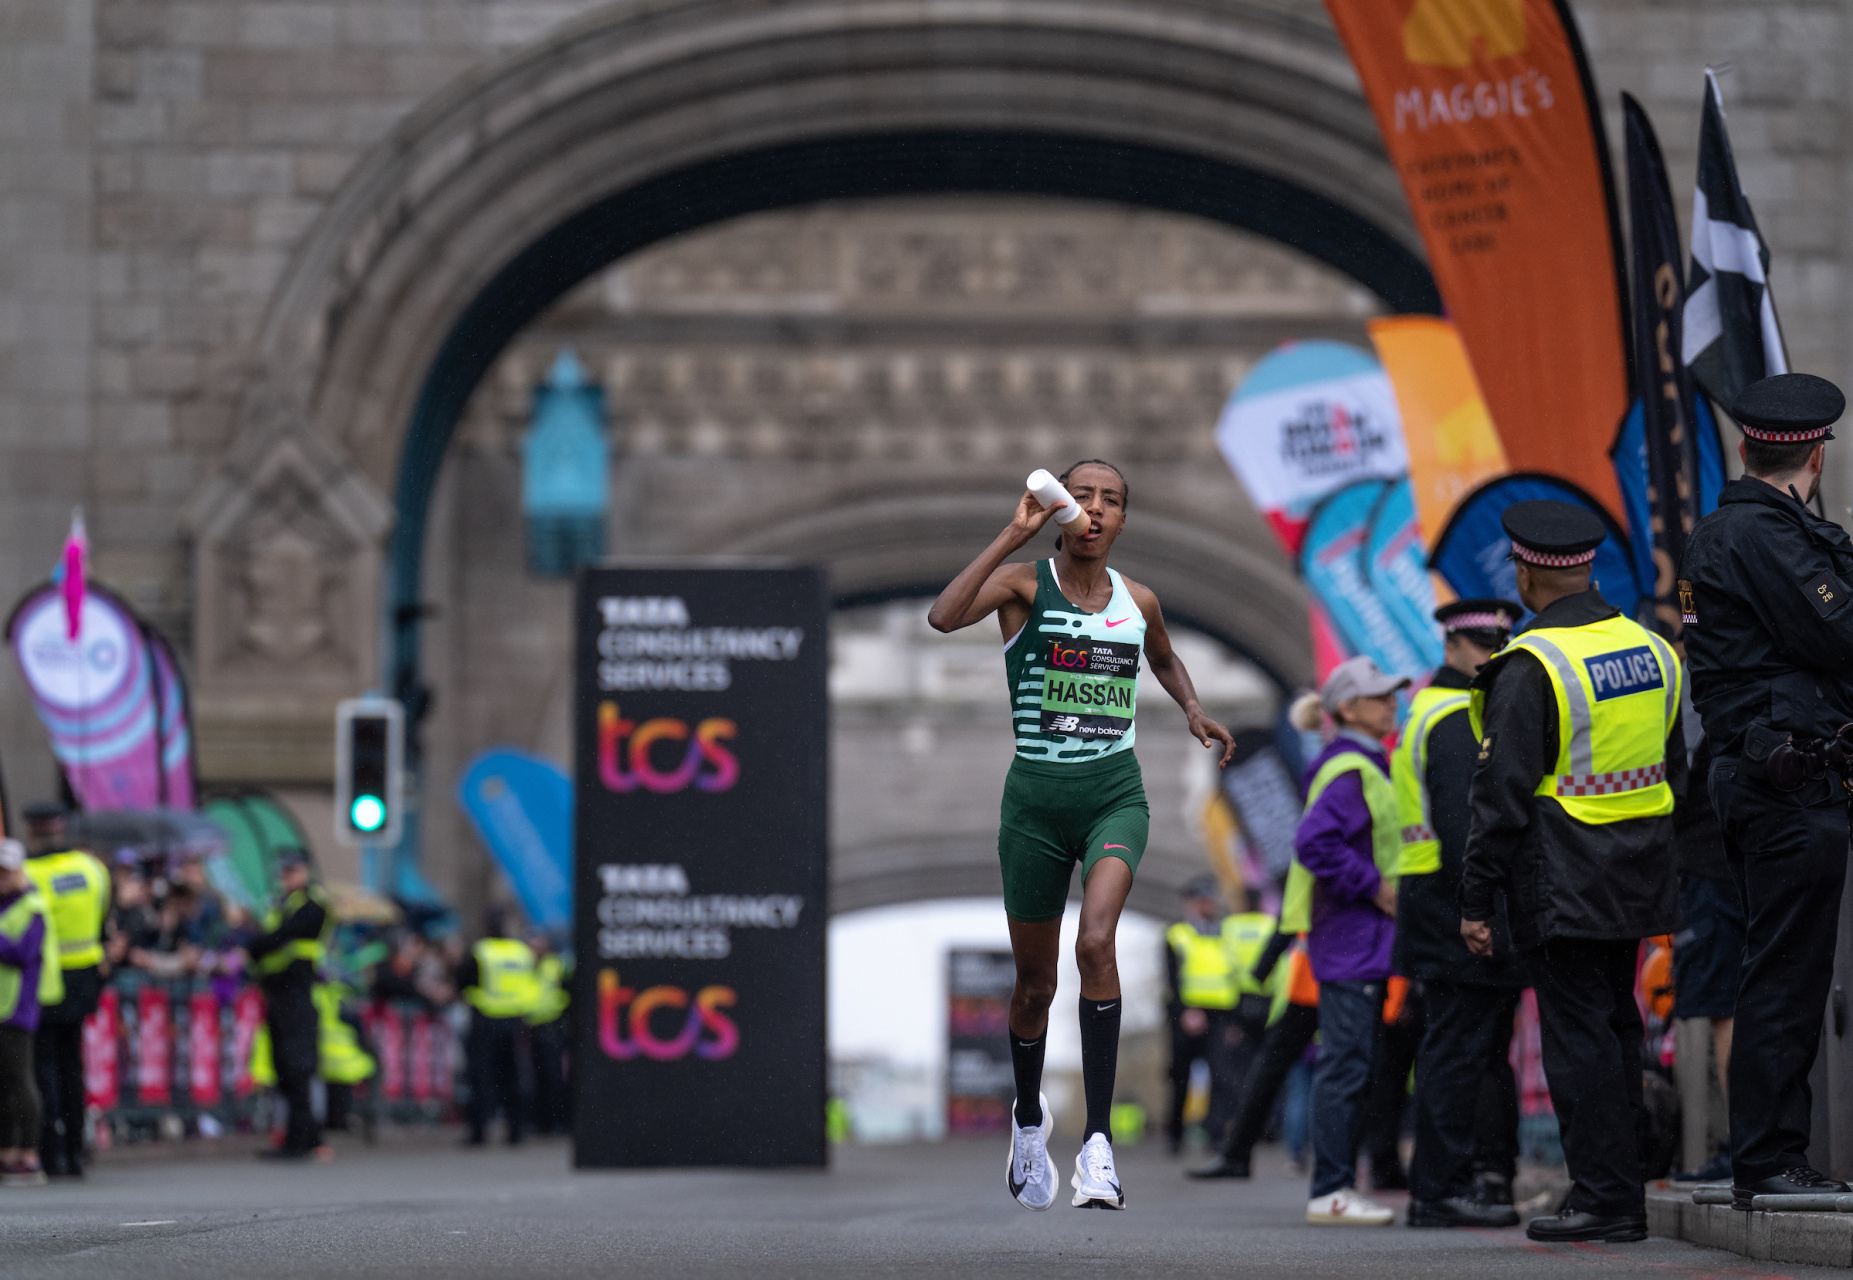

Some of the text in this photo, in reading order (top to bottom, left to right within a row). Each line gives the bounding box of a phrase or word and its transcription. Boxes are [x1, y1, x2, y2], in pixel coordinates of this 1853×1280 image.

[1394, 67, 1555, 132] MAGGIE'S
[1817, 584, 1827, 594] CP
[1822, 591, 1834, 603] 210
[598, 627, 804, 661] CONSULTANCY
[1053, 643, 1088, 668] tcs
[1093, 647, 1113, 655] TATA
[598, 660, 732, 692] SERVICES
[1089, 662, 1121, 672] SERVICES
[1091, 655, 1134, 666] CONSULTANCY
[1589, 652, 1661, 693] POLICE
[1047, 679, 1131, 709] HASSAN
[1080, 726, 1126, 736] new balanc
[597, 700, 740, 794] tcs
[597, 895, 804, 929] CONSULTANCY
[597, 927, 732, 960] SERVICES
[597, 968, 740, 1062] tcs
